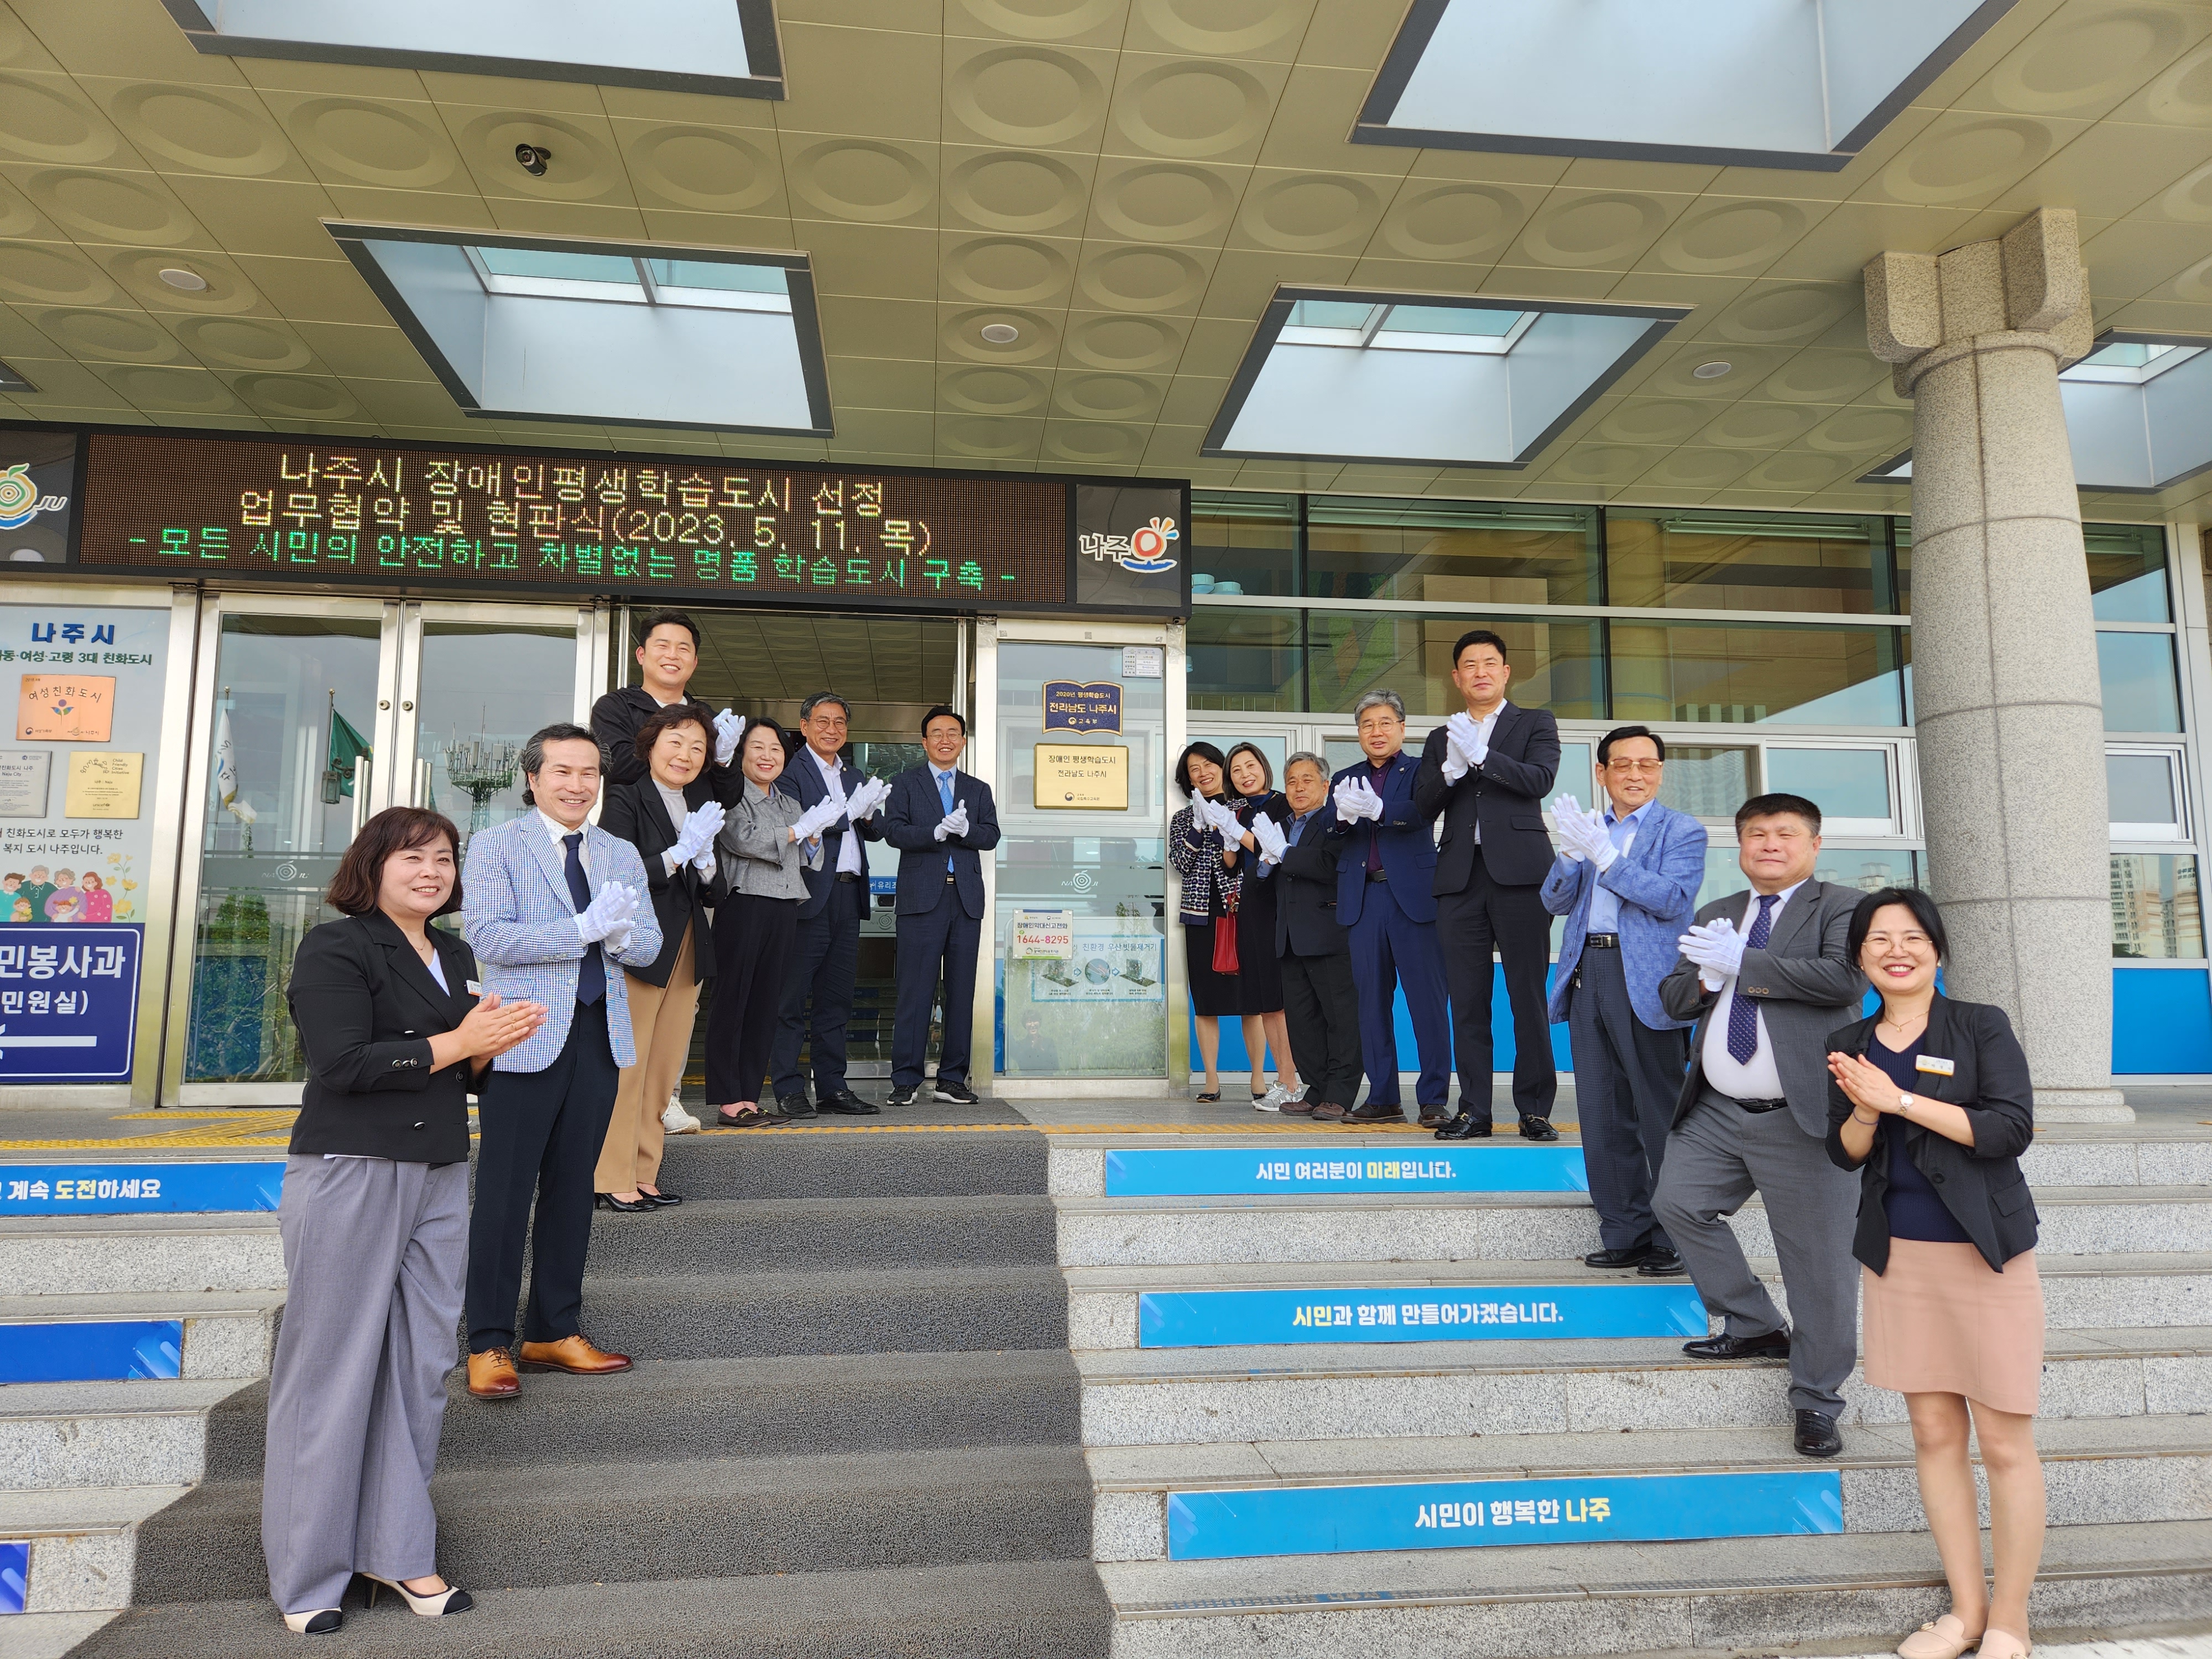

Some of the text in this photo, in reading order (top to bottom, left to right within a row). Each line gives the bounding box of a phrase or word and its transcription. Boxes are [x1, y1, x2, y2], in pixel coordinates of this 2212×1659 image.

[280, 452, 884, 518] 나주시 장애인평생학습도시 선정
[240, 488, 411, 533] 업무협약
[431, 499, 465, 535] 및
[879, 519, 932, 557] 목)
[158, 526, 231, 561] 모든
[249, 530, 357, 565] 시민의
[376, 533, 520, 570] 안전하고
[538, 540, 681, 580] 차별없는
[692, 550, 759, 583] 명품
[773, 551, 907, 590] 학습도시
[922, 558, 984, 592] 구축
[1079, 533, 1131, 563] 나주
[32, 622, 115, 645] 나주시
[78, 652, 98, 664] 3대
[103, 653, 153, 665] 친화도시
[29, 685, 102, 703] 여성친화도시
[1050, 702, 1117, 714] 전라남도 나주시
[1073, 755, 1116, 764] 평생학습도시
[6, 828, 56, 838] 친화도시로
[59, 829, 90, 839] 모두가
[93, 830, 123, 839] 행복한
[3, 843, 103, 854] 복지 도시 나주입니다.
[1016, 935, 1069, 944] 1644-8295
[0, 945, 126, 979] 민봉사과
[1, 990, 88, 1015] 민원실)
[1256, 1161, 1457, 1180] 시민 여러분이 미래입니다.
[7, 1178, 161, 1200] 계속 도전하세요
[1293, 1302, 1564, 1327] 시민과 함께 만들어가겠습니다.
[1415, 1498, 1611, 1528] 시민이 행복한 나주
